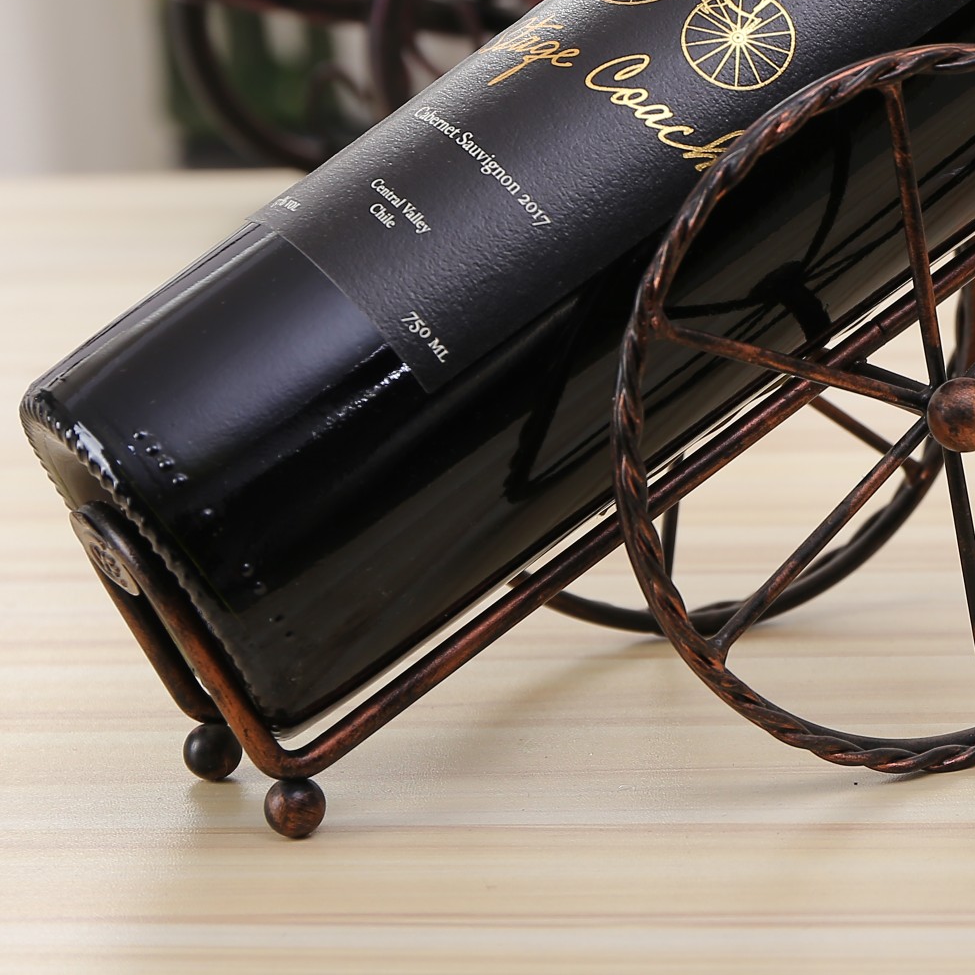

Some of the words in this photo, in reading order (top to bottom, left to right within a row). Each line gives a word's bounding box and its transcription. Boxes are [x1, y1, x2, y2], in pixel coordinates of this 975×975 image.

[413, 106, 460, 140] Cabernet
[455, 131, 521, 196] Sauvignon
[518, 194, 552, 228] 2017
[369, 203, 396, 229] Chile
[370, 178, 403, 209] Central
[400, 203, 432, 235] Valley
[400, 311, 432, 340] 750
[427, 336, 451, 363] ML
